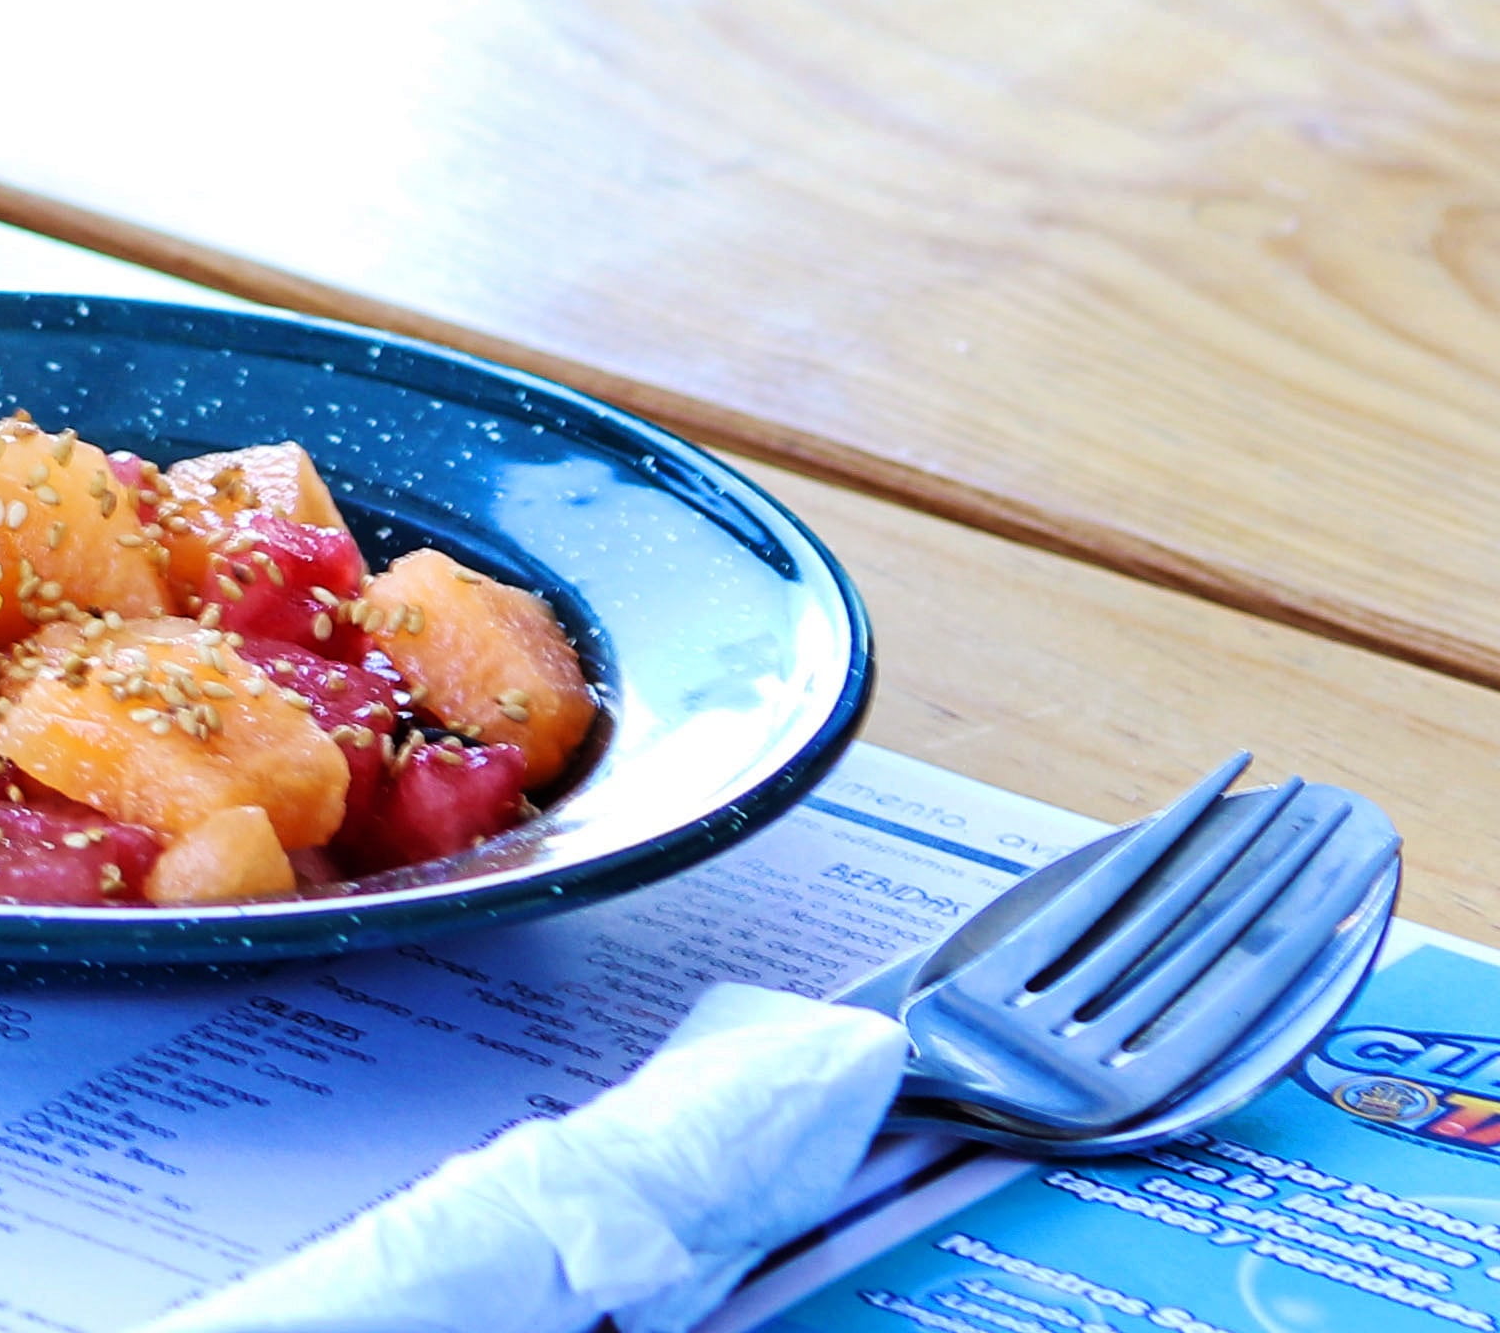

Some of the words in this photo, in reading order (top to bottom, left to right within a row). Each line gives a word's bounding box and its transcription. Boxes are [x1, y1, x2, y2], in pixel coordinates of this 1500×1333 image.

[820, 863, 972, 919] BEBIDAS
[1141, 1175, 1222, 1210] tus
[1204, 1139, 1350, 1192] mejor
[1042, 1167, 1224, 1235] tapetes
[1278, 1191, 1481, 1268] limpieza
[933, 1231, 1153, 1317] Nuestros
